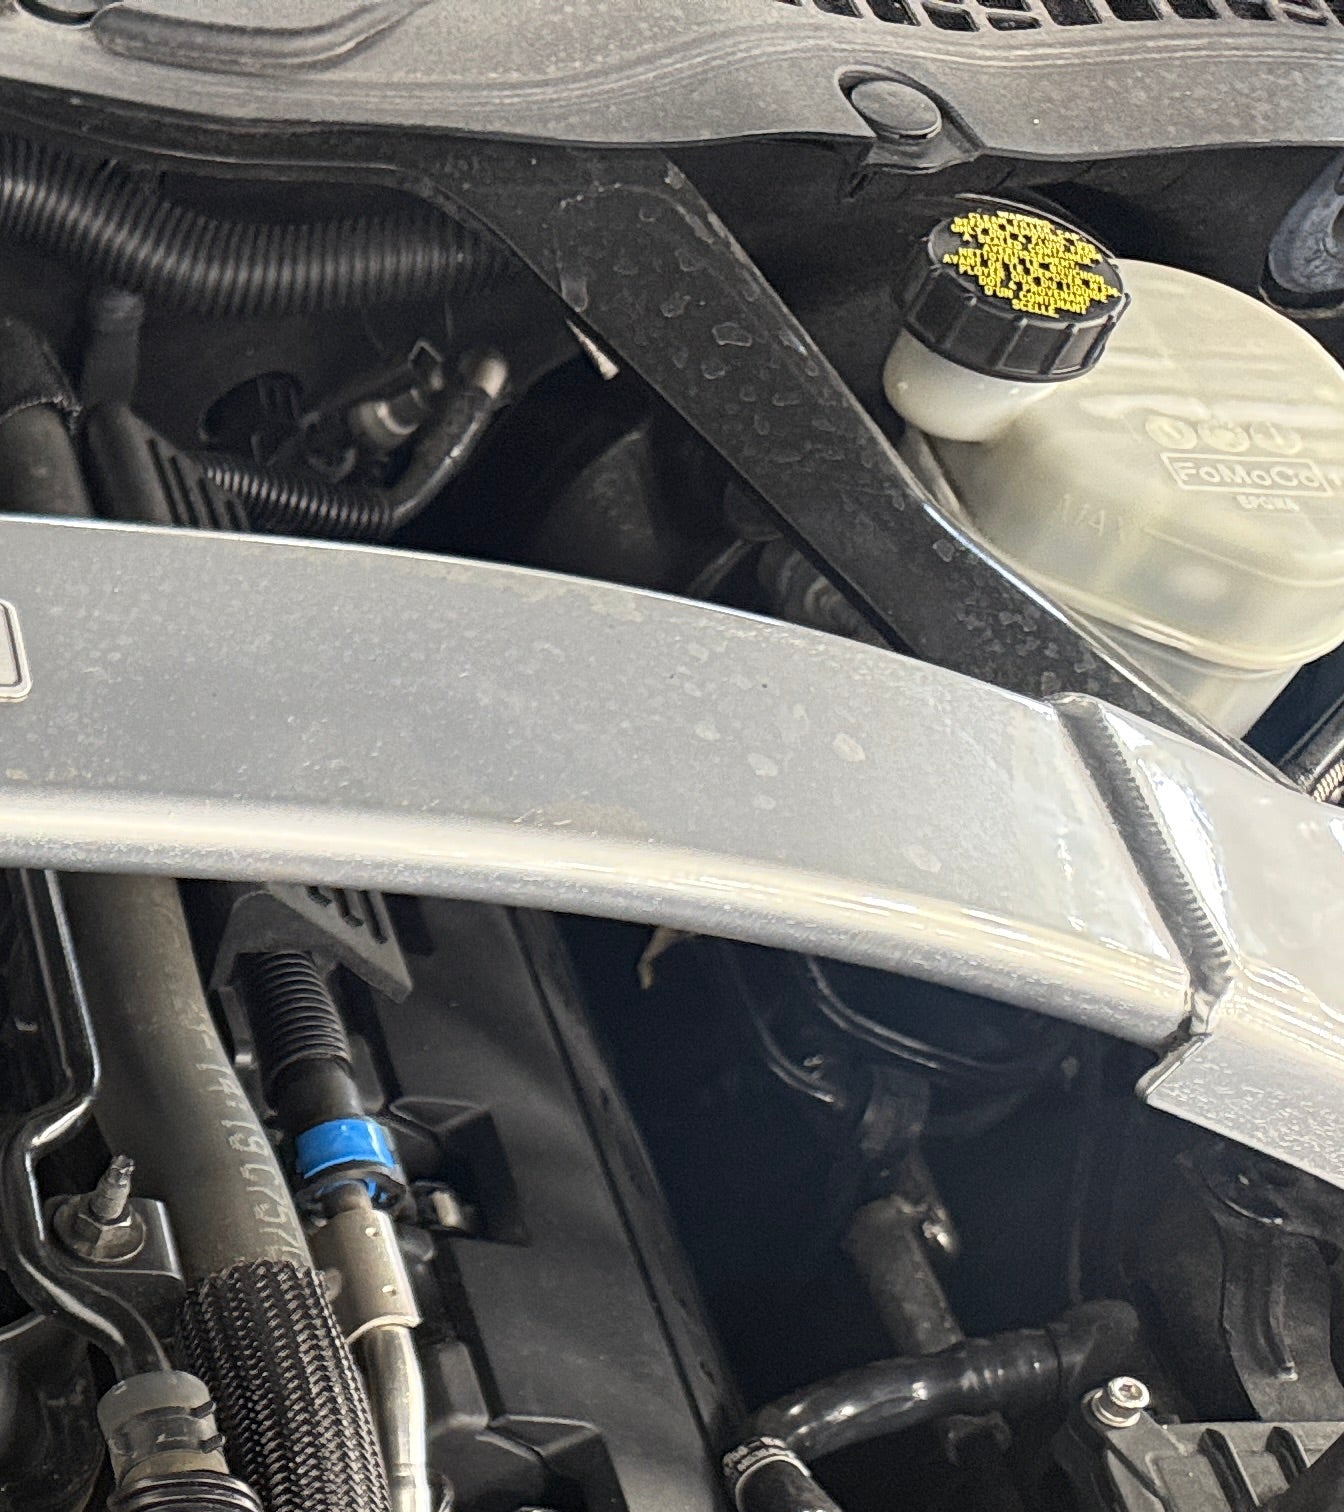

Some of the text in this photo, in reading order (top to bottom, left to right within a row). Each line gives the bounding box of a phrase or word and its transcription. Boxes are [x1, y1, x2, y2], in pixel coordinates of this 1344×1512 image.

[942, 253, 981, 269] AVANT
[978, 274, 1001, 288] DOT
[1022, 282, 1090, 306] PROVENANT
[1019, 290, 1087, 314] CONTENANT
[1172, 461, 1322, 488] FoMoCo
